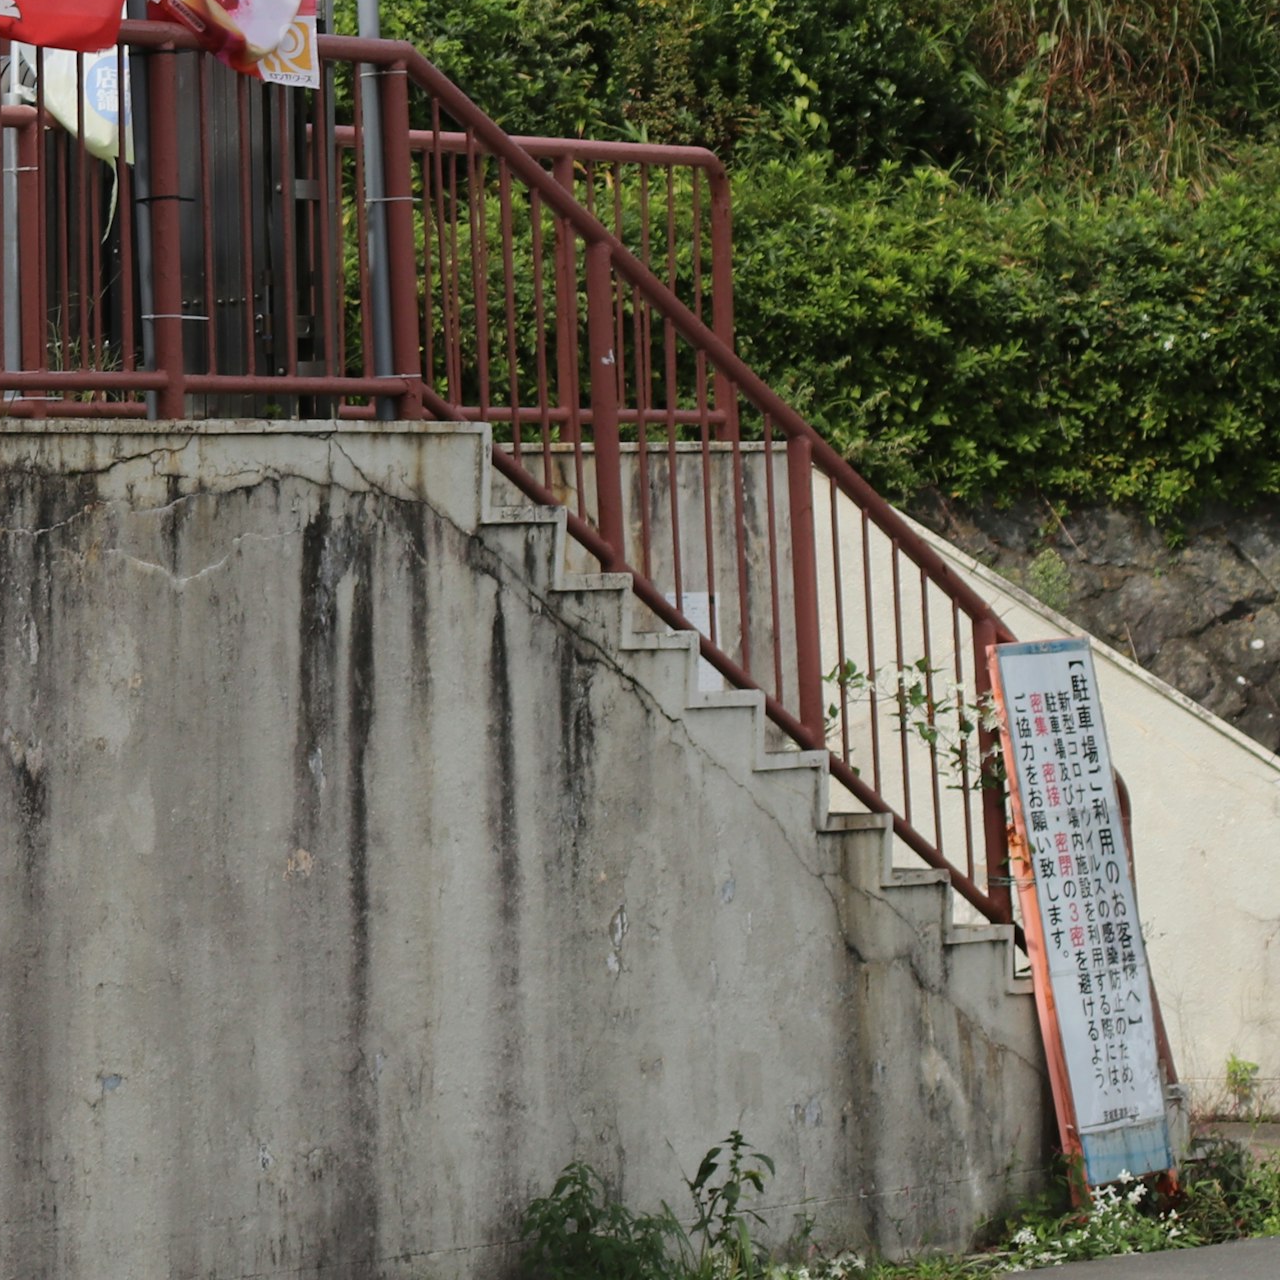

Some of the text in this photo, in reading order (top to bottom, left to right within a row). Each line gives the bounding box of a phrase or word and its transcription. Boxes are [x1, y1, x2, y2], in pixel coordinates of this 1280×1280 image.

[1014, 693, 1070, 960] ご協力をお願い致します。
[1044, 692, 1121, 1095] 駐車場及び場内施設を利用する際には、
[1058, 691, 1136, 1093] 新型コロナウイルスの感染防止のため、
